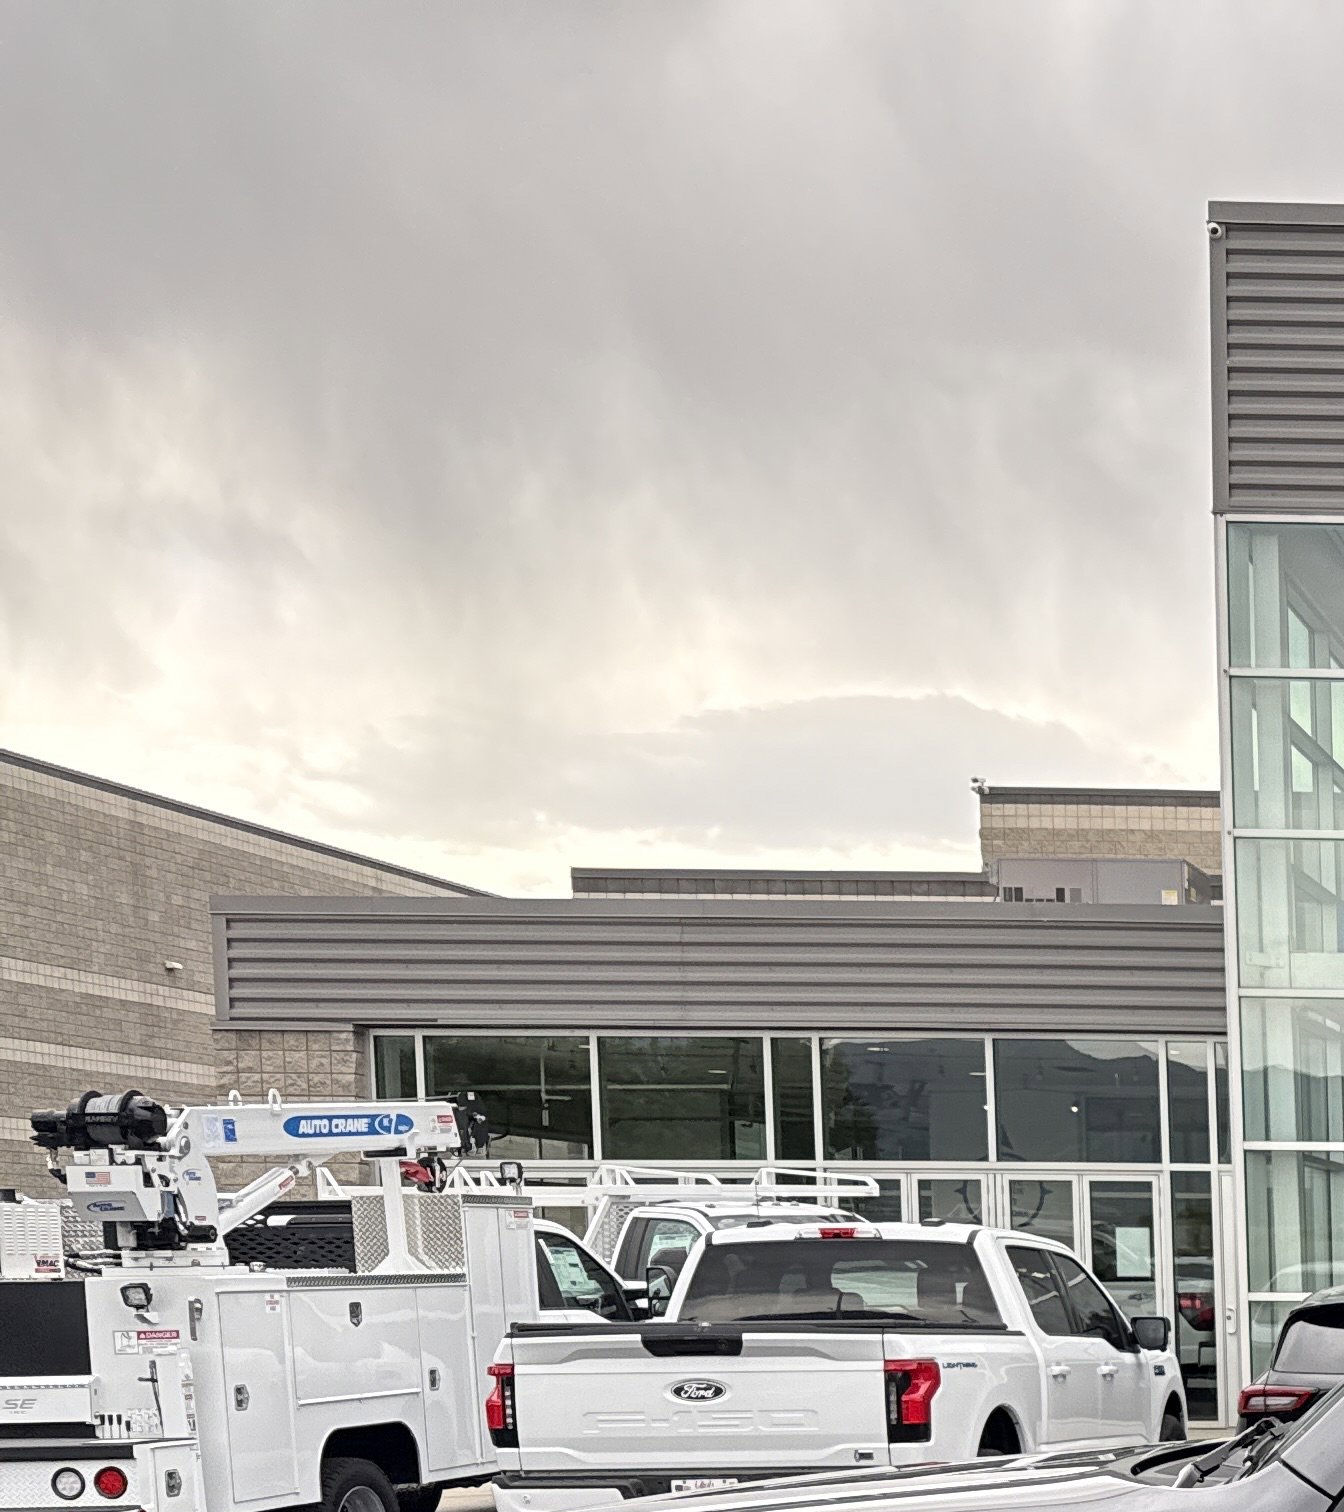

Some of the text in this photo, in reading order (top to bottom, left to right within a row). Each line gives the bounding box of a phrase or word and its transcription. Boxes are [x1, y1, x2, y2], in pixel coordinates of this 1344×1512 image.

[298, 1119, 329, 1134] AUTO
[332, 1118, 369, 1133] CRANE
[582, 1410, 819, 1434] F-150
